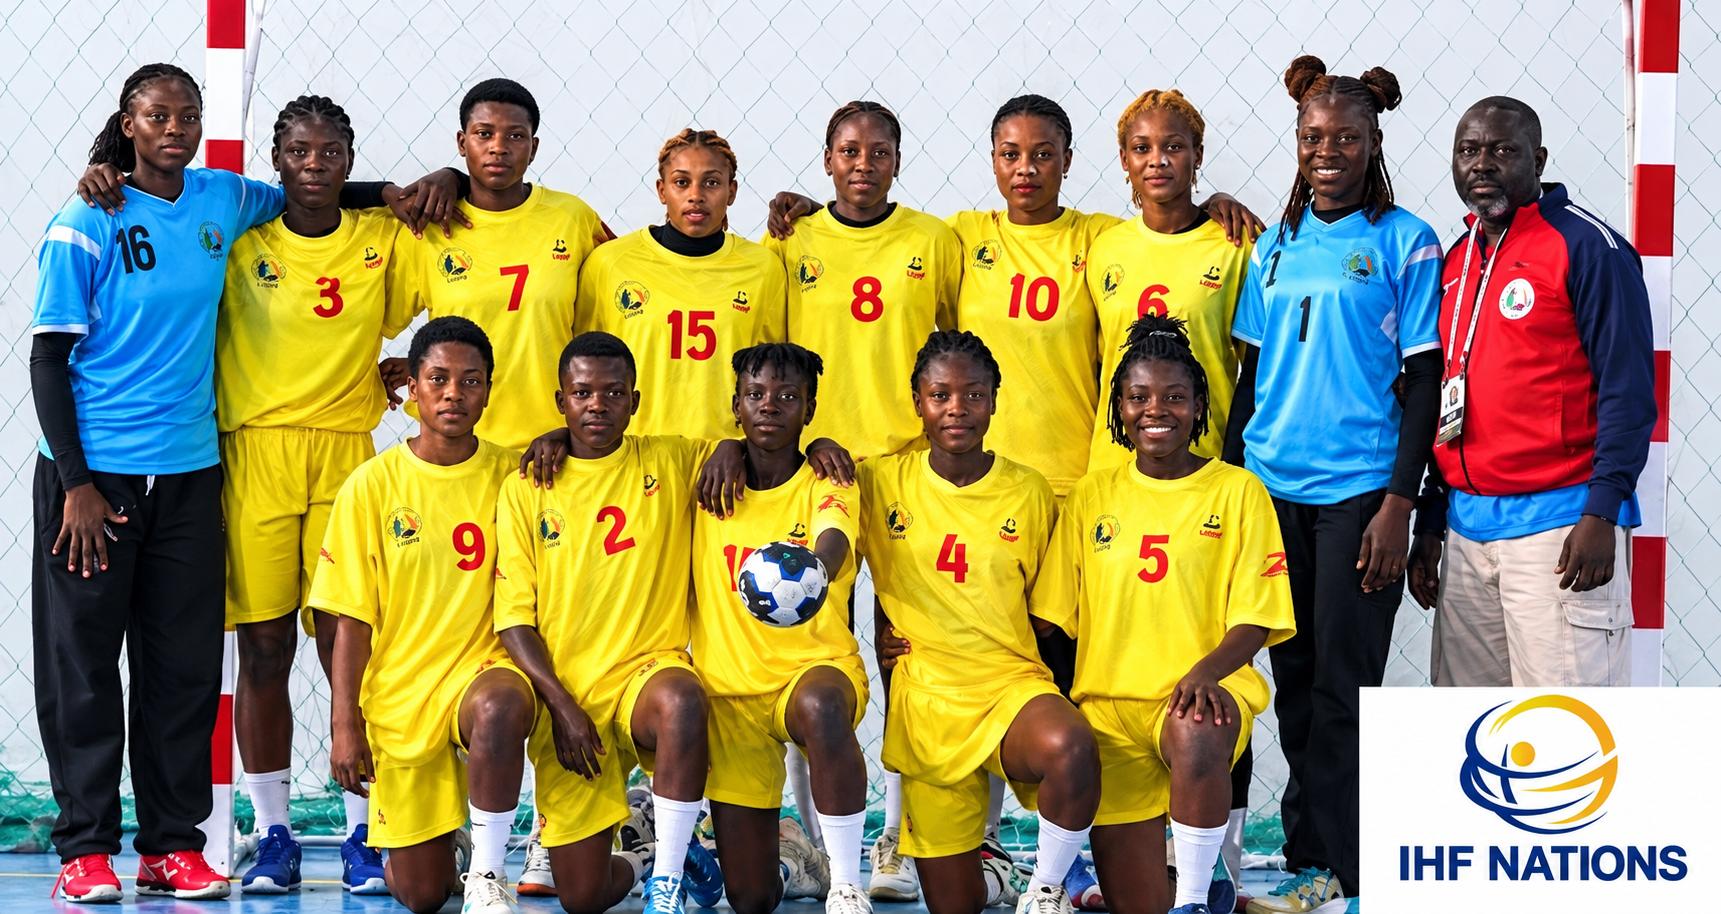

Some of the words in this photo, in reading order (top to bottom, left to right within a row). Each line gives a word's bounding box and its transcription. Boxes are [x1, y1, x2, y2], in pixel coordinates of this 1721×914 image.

[116, 225, 156, 274] 16
[1265, 250, 1281, 288] 1
[313, 277, 343, 318] 3
[500, 264, 529, 311] 7
[851, 276, 884, 322] 8
[1008, 273, 1060, 321] 10
[1138, 284, 1169, 320] 6
[667, 310, 717, 361] 15
[1298, 296, 1311, 342] 1
[452, 522, 486, 571] 9
[597, 506, 636, 555] 2
[936, 534, 968, 583] 4
[1137, 534, 1170, 583] 5
